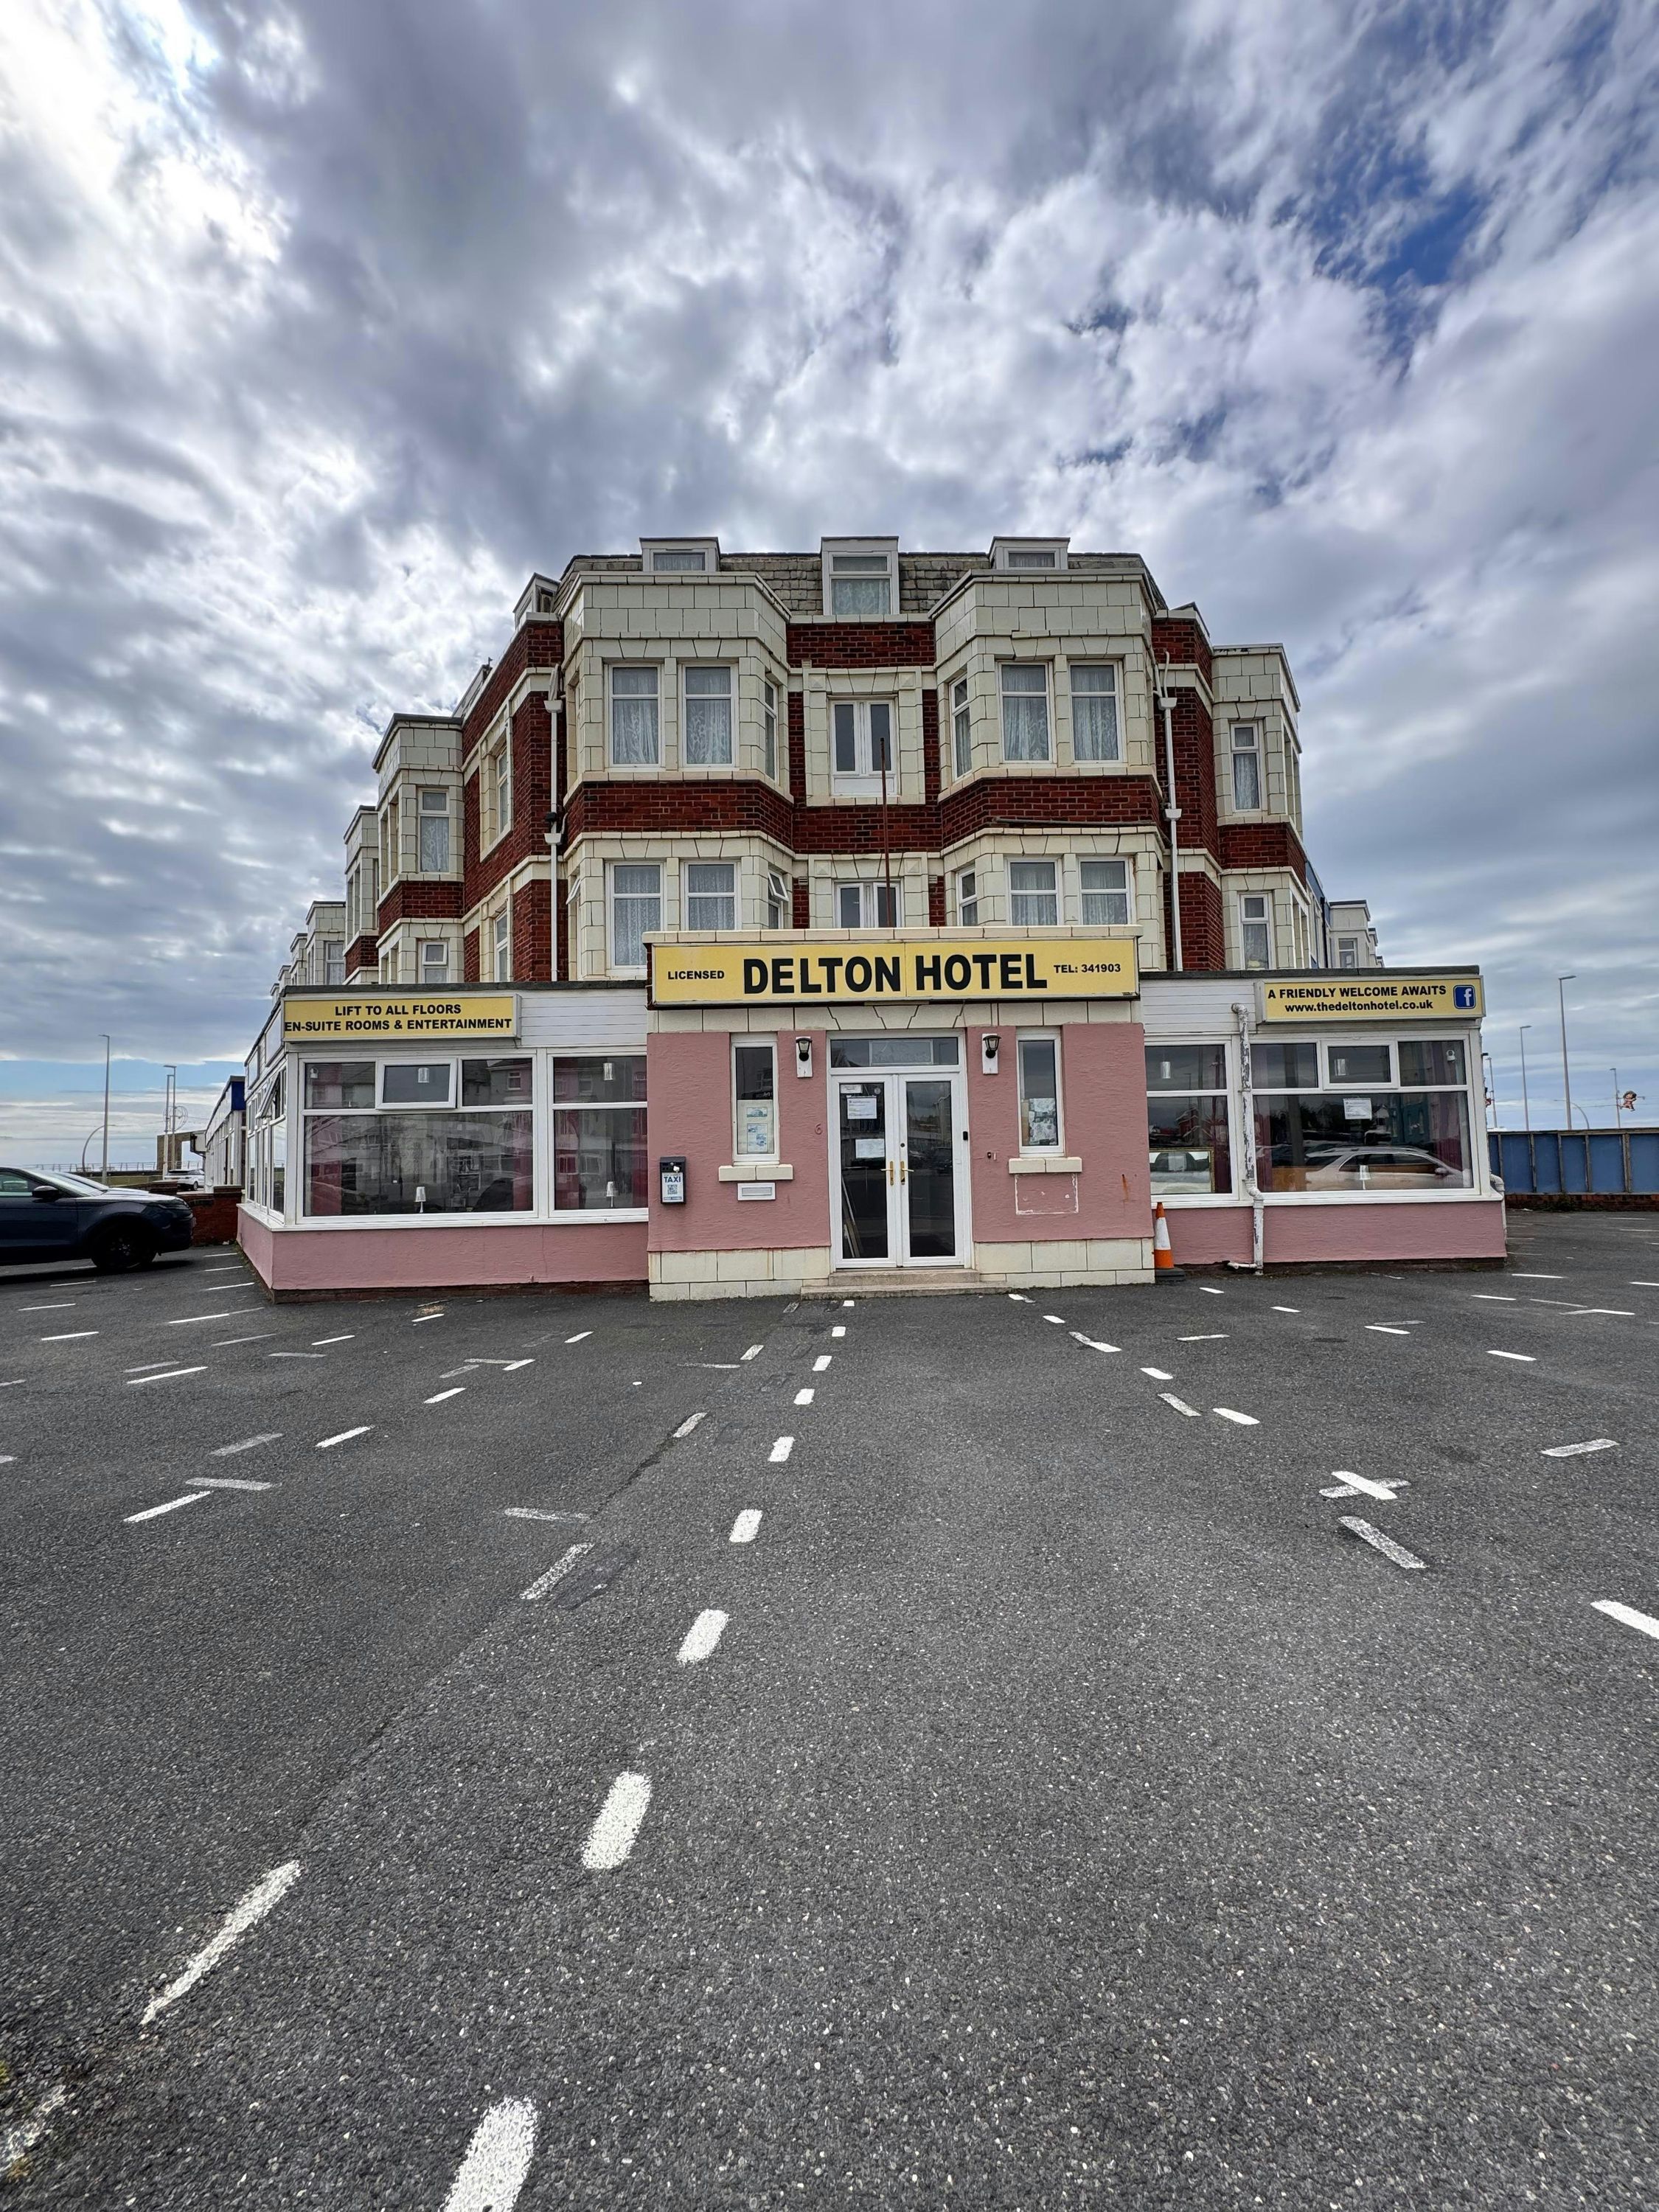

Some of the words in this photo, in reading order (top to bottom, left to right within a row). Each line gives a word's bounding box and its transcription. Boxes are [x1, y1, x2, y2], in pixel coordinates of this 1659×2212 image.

[667, 970, 725, 980] LICENSED
[743, 956, 901, 995] DELTON
[915, 953, 1048, 991] HOTEL
[1053, 964, 1078, 974] TEL:
[1081, 963, 1121, 973] 341903
[1267, 989, 1276, 999] A
[1279, 987, 1337, 999] FRIENDLY
[1338, 986, 1398, 998] WELCOME
[1401, 985, 1447, 996] AWAITS
[1464, 988, 1472, 1006] f
[335, 1005, 362, 1016] LIFT
[365, 1005, 382, 1016] TO
[385, 1005, 409, 1015] ALL
[412, 1004, 462, 1015] FLOORS
[1284, 999, 1434, 1012] www.thedeltonhotel.co.uk
[285, 1020, 341, 1032] EN-SUITE
[345, 1020, 390, 1031] ROOMS
[394, 1019, 403, 1030] &
[407, 1018, 512, 1030] ENTERTAINMENT
[815, 1124, 823, 1135] 6
